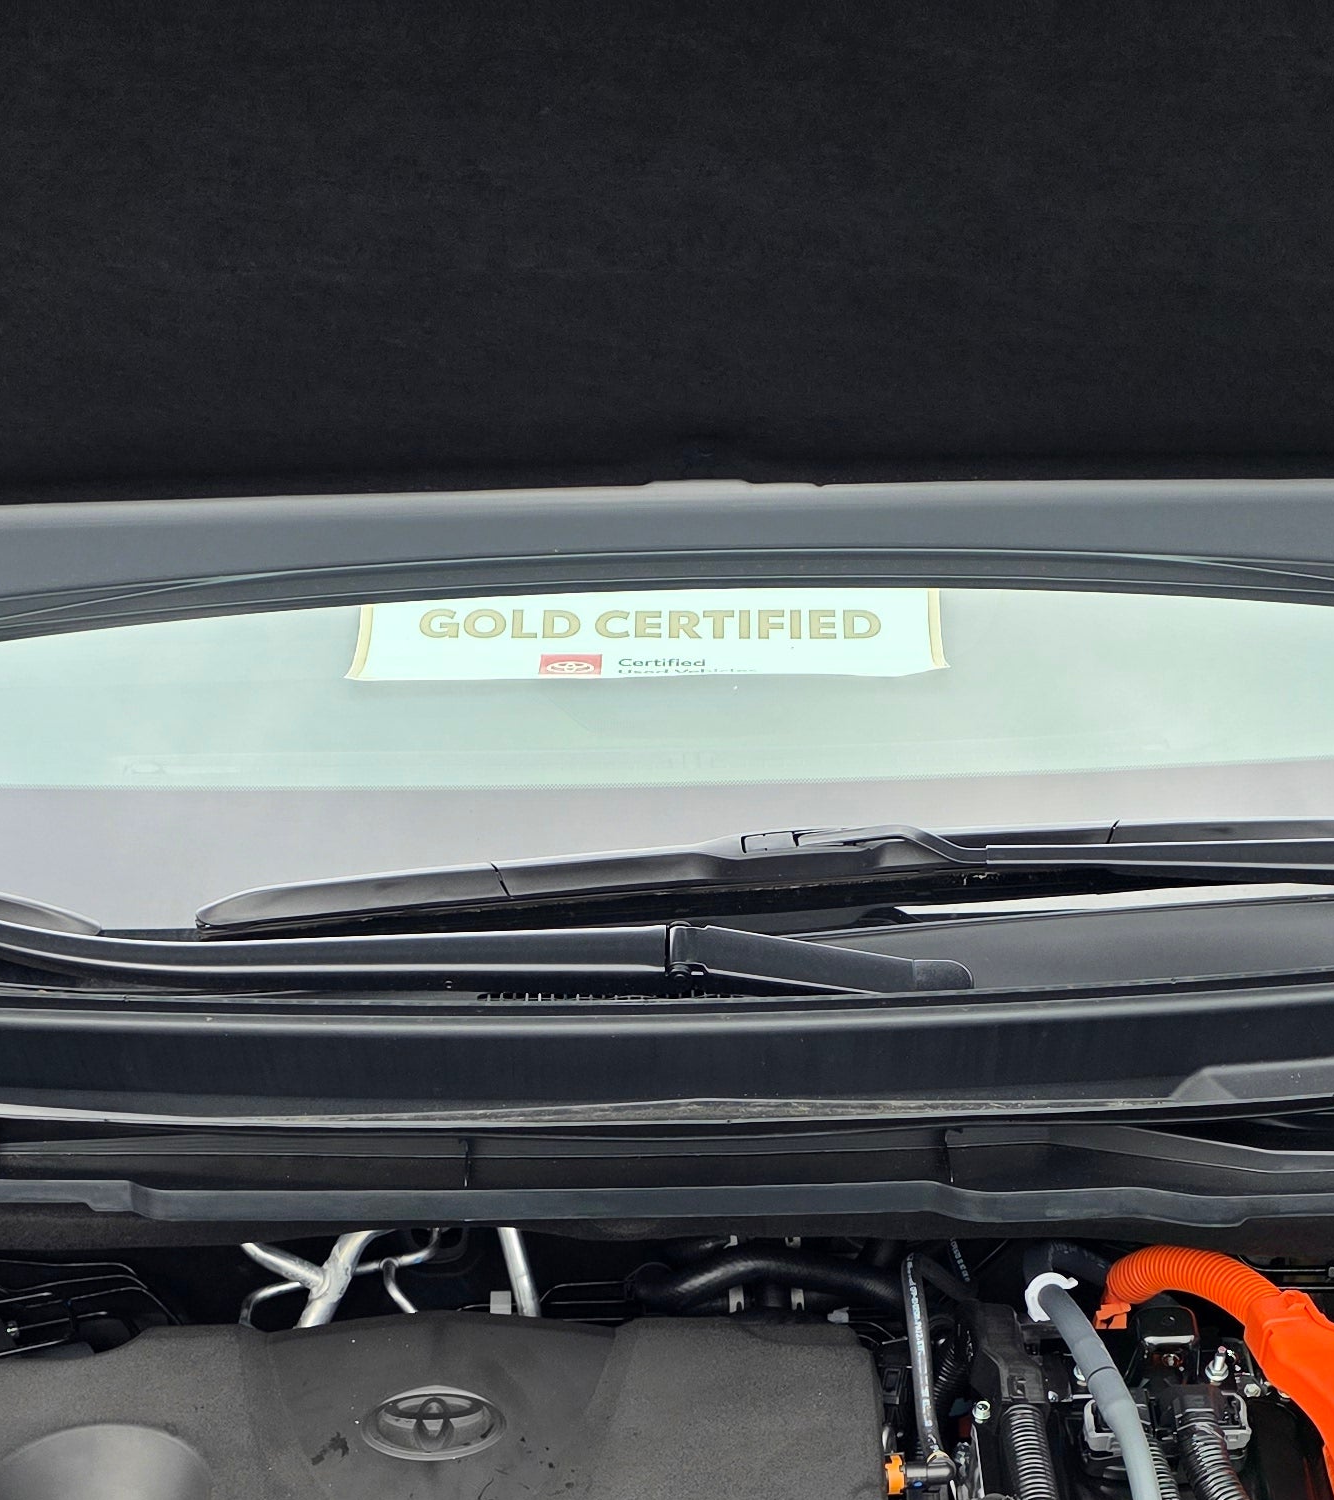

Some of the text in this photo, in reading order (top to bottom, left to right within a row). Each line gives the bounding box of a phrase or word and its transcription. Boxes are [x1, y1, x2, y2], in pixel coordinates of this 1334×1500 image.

[419, 608, 883, 640] GOLD CERTIFIED
[618, 658, 706, 667] Certified
